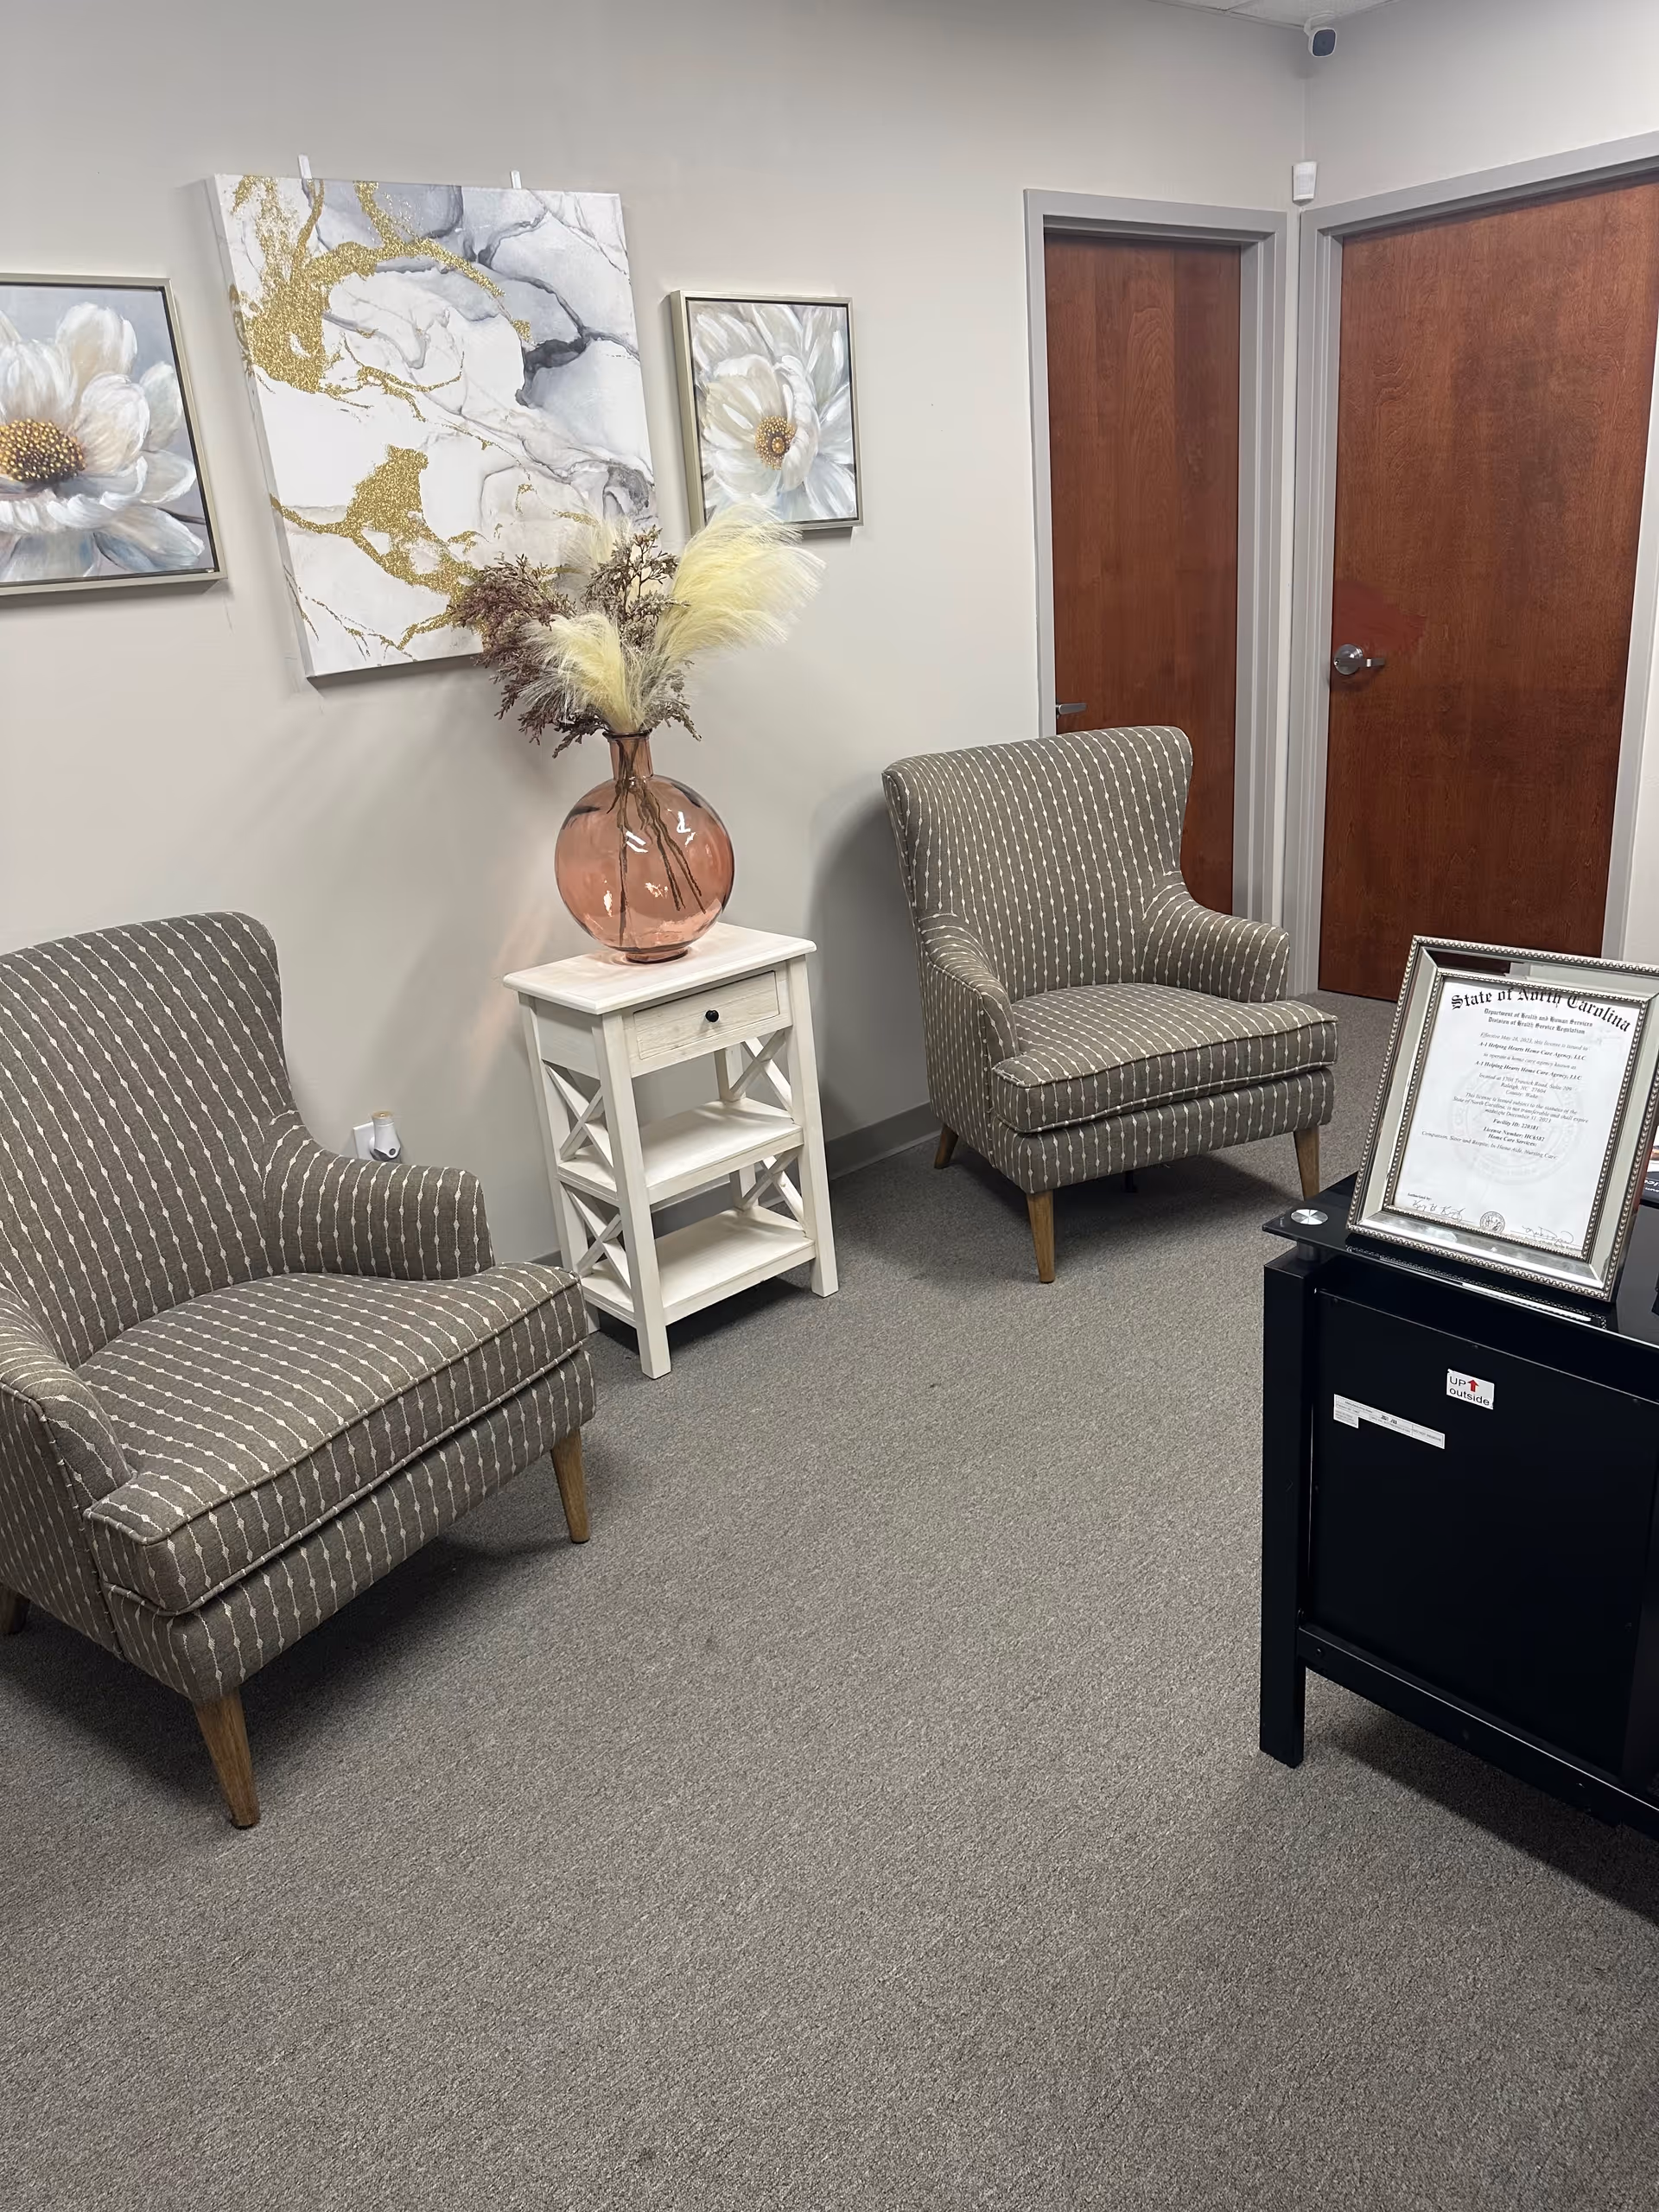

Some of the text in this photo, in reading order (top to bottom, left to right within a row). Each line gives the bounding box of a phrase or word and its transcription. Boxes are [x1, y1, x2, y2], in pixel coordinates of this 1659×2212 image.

[1452, 987, 1630, 1032] State of North Carolina
[1484, 1008, 1513, 1017] Department
[1570, 1019, 1593, 1027] Services
[1556, 1025, 1585, 1034] Regulation
[1521, 1108, 1549, 1116] transferable
[1449, 1376, 1466, 1386] UP
[1449, 1388, 1489, 1405] outside
